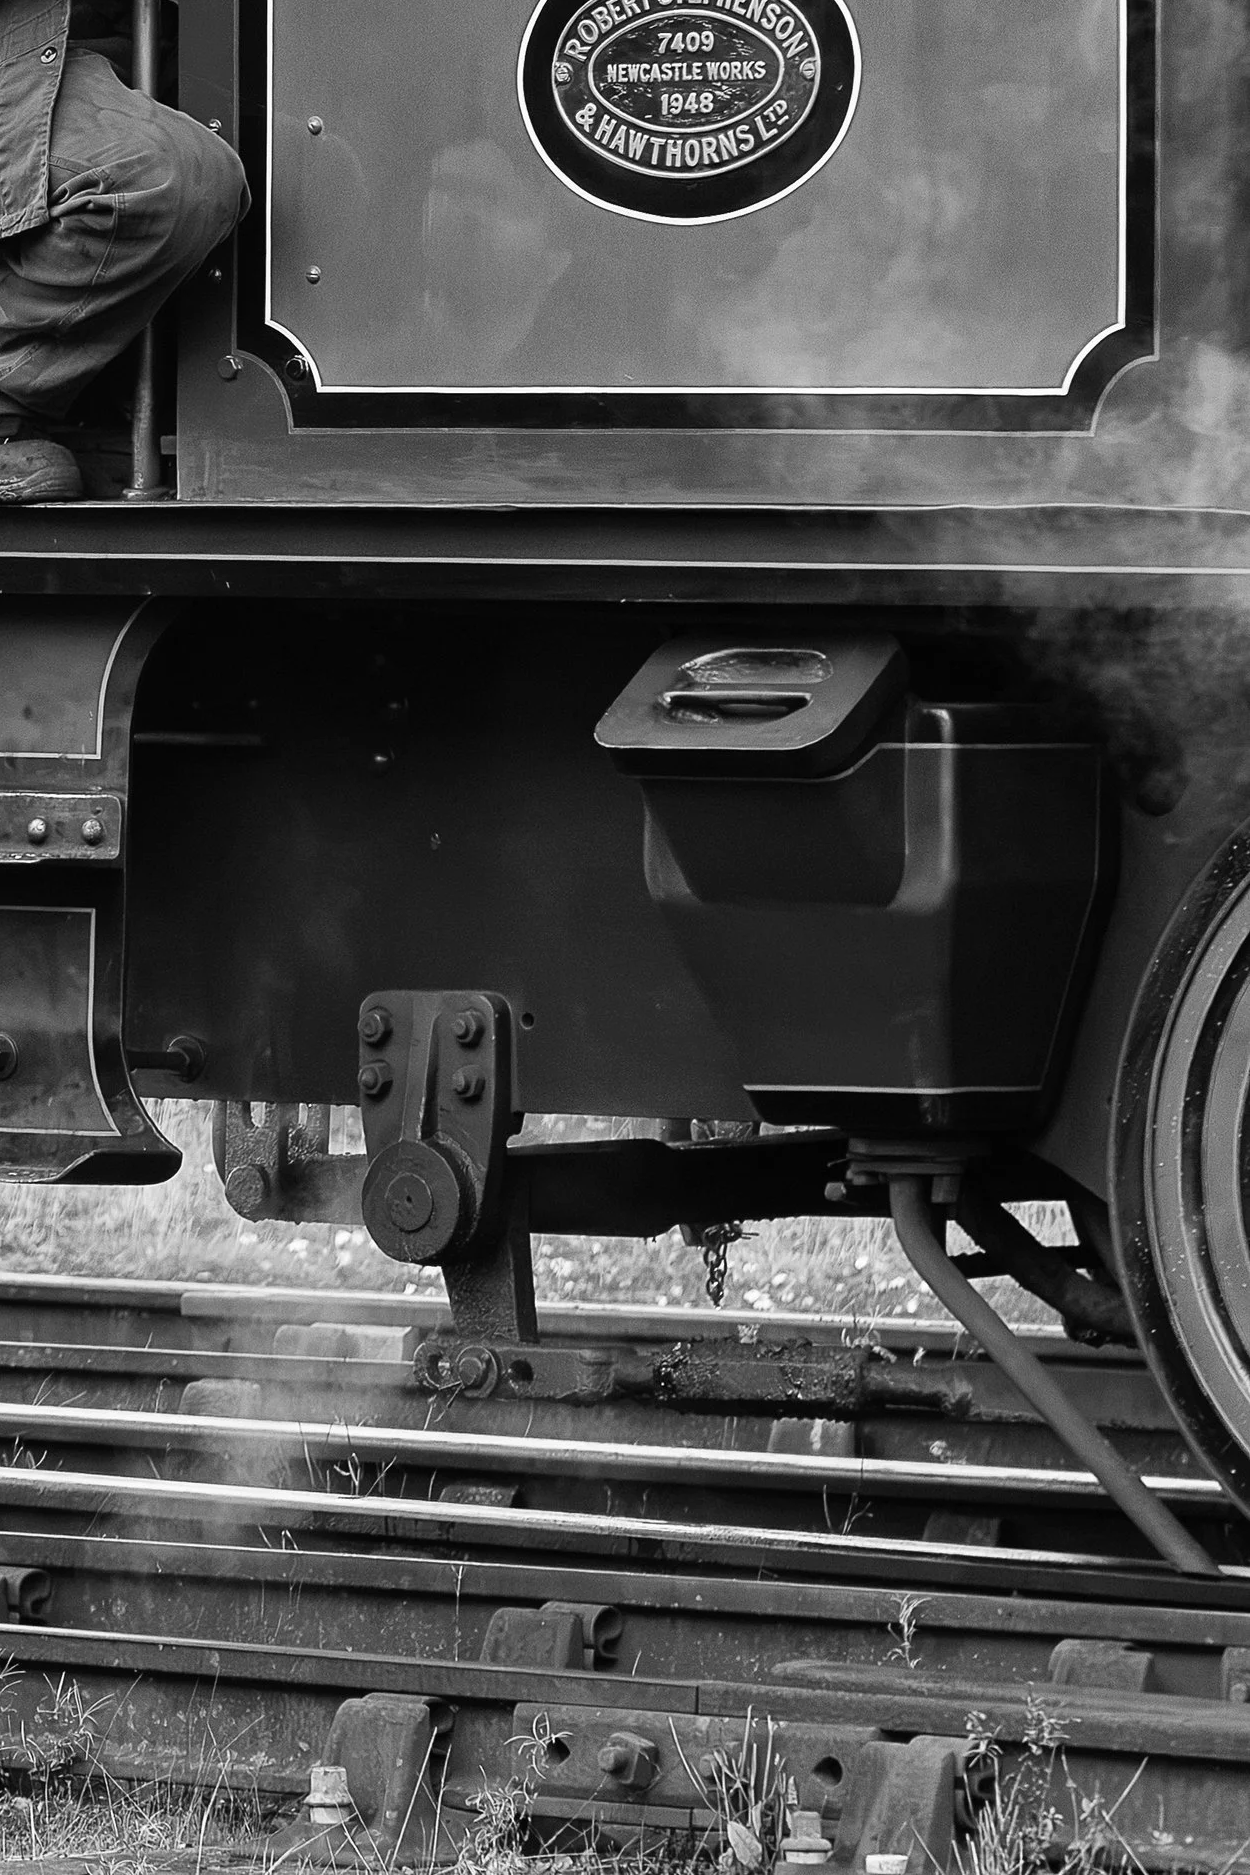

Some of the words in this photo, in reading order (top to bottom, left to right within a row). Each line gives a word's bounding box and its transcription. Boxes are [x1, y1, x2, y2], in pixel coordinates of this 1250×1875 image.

[657, 30, 715, 54] 7409
[606, 62, 703, 83] NEWCASTLE
[706, 60, 767, 81] WORKS
[660, 92, 715, 116] 1948
[575, 102, 598, 133] &
[594, 113, 756, 168] HAWTHORNS
